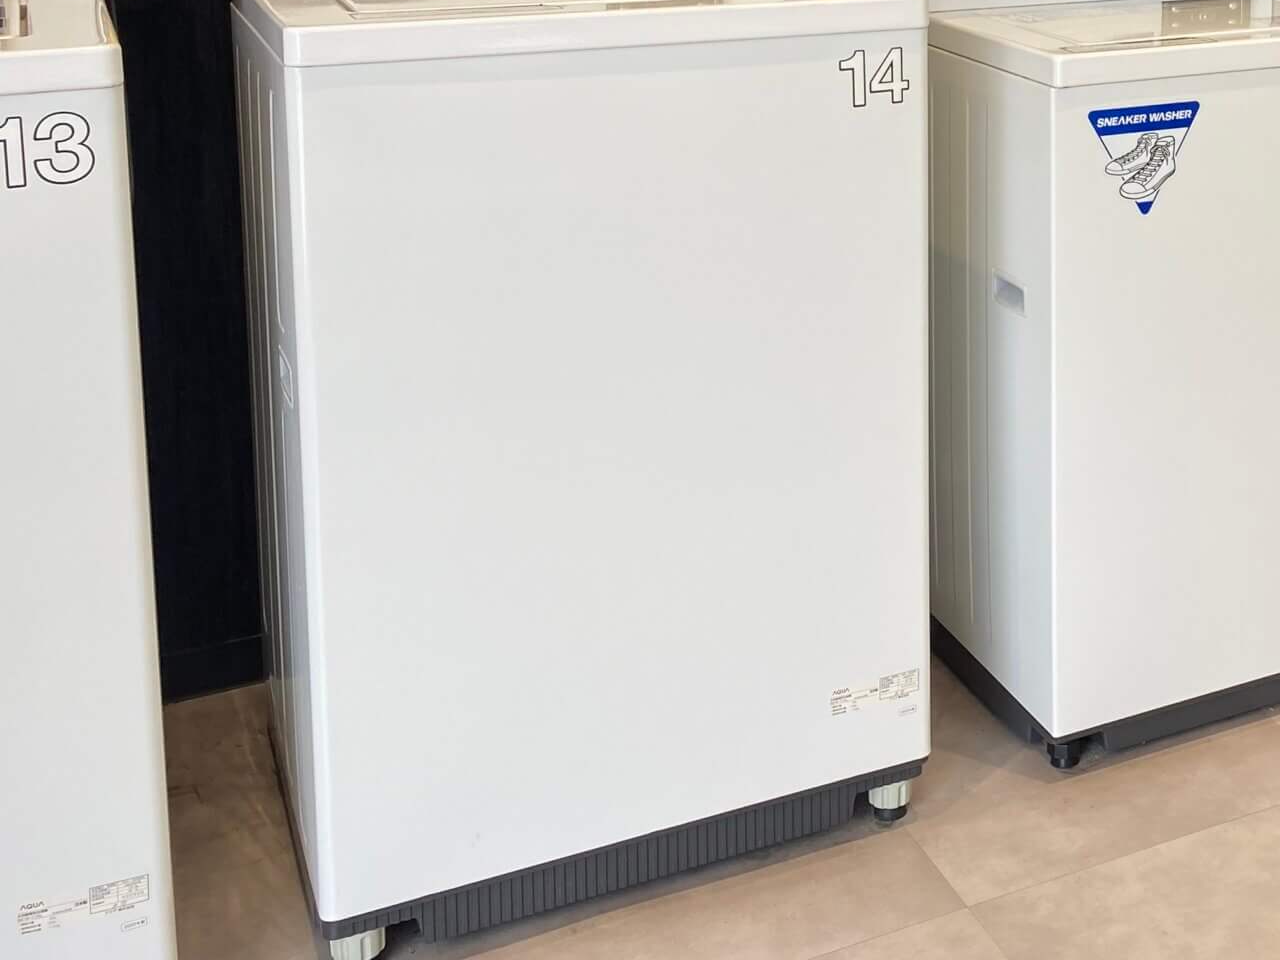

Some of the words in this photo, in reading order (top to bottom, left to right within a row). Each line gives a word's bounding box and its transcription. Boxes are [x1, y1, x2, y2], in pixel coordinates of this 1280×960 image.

[838, 46, 910, 108] 14
[0, 110, 95, 189] 13
[1096, 113, 1147, 128] SNEAKER
[1148, 109, 1193, 123] WASHER
